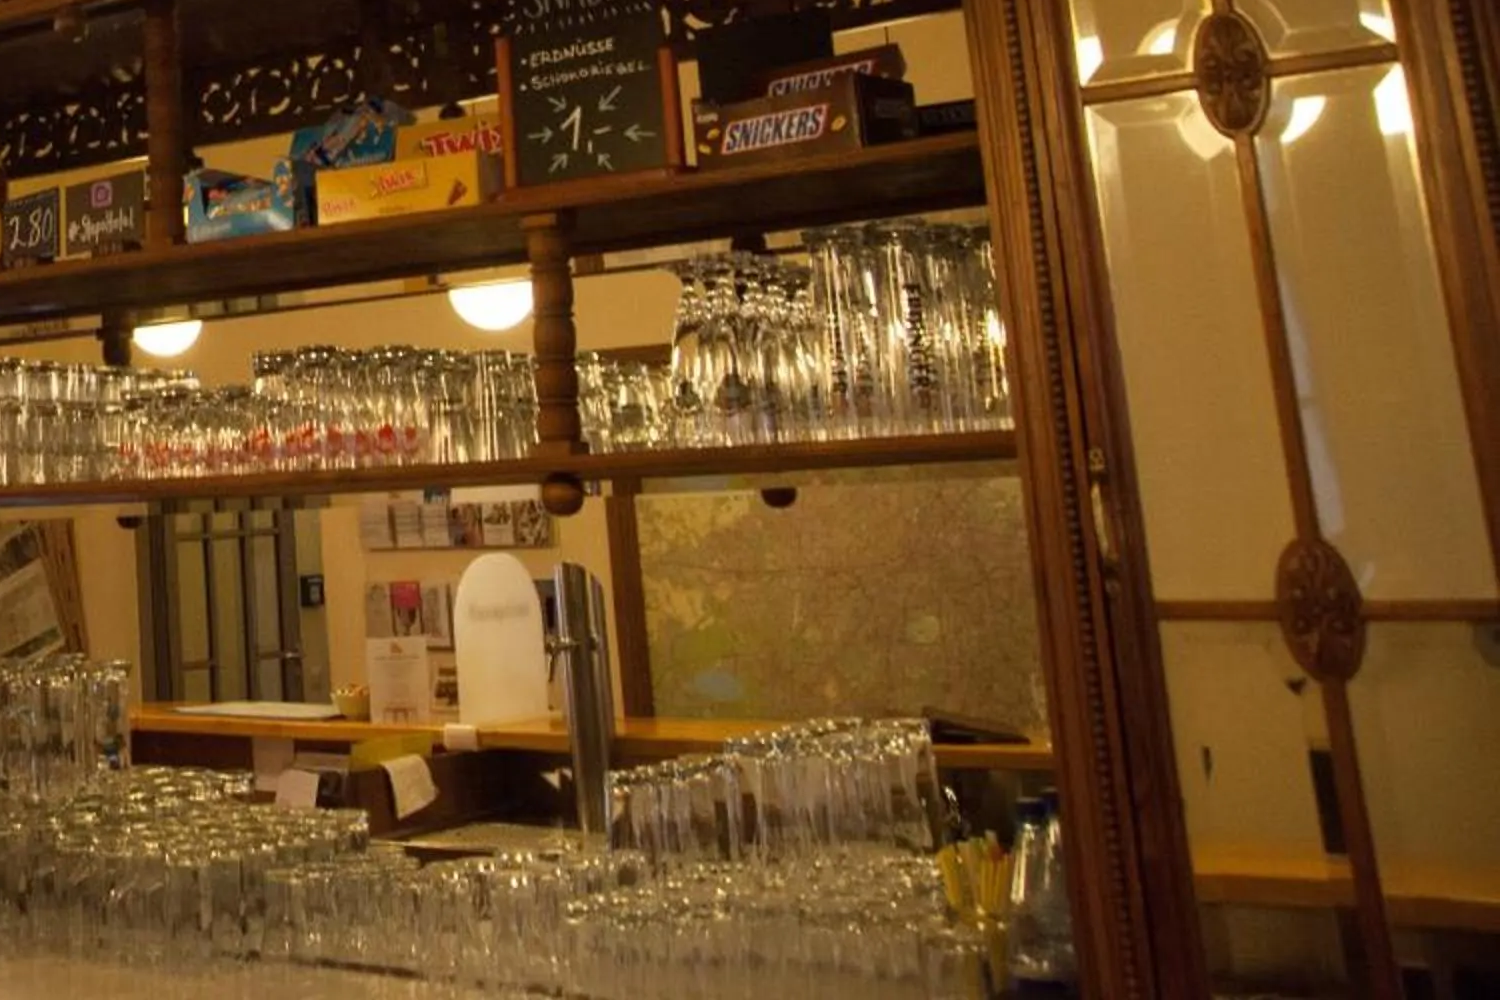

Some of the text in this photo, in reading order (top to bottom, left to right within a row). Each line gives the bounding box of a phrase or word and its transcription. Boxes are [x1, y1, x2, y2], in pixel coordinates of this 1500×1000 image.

[528, 36, 615, 68] ERDNÜSSE
[530, 60, 648, 91] SCHOKORIEGEL
[724, 106, 825, 152] SNICKERS
